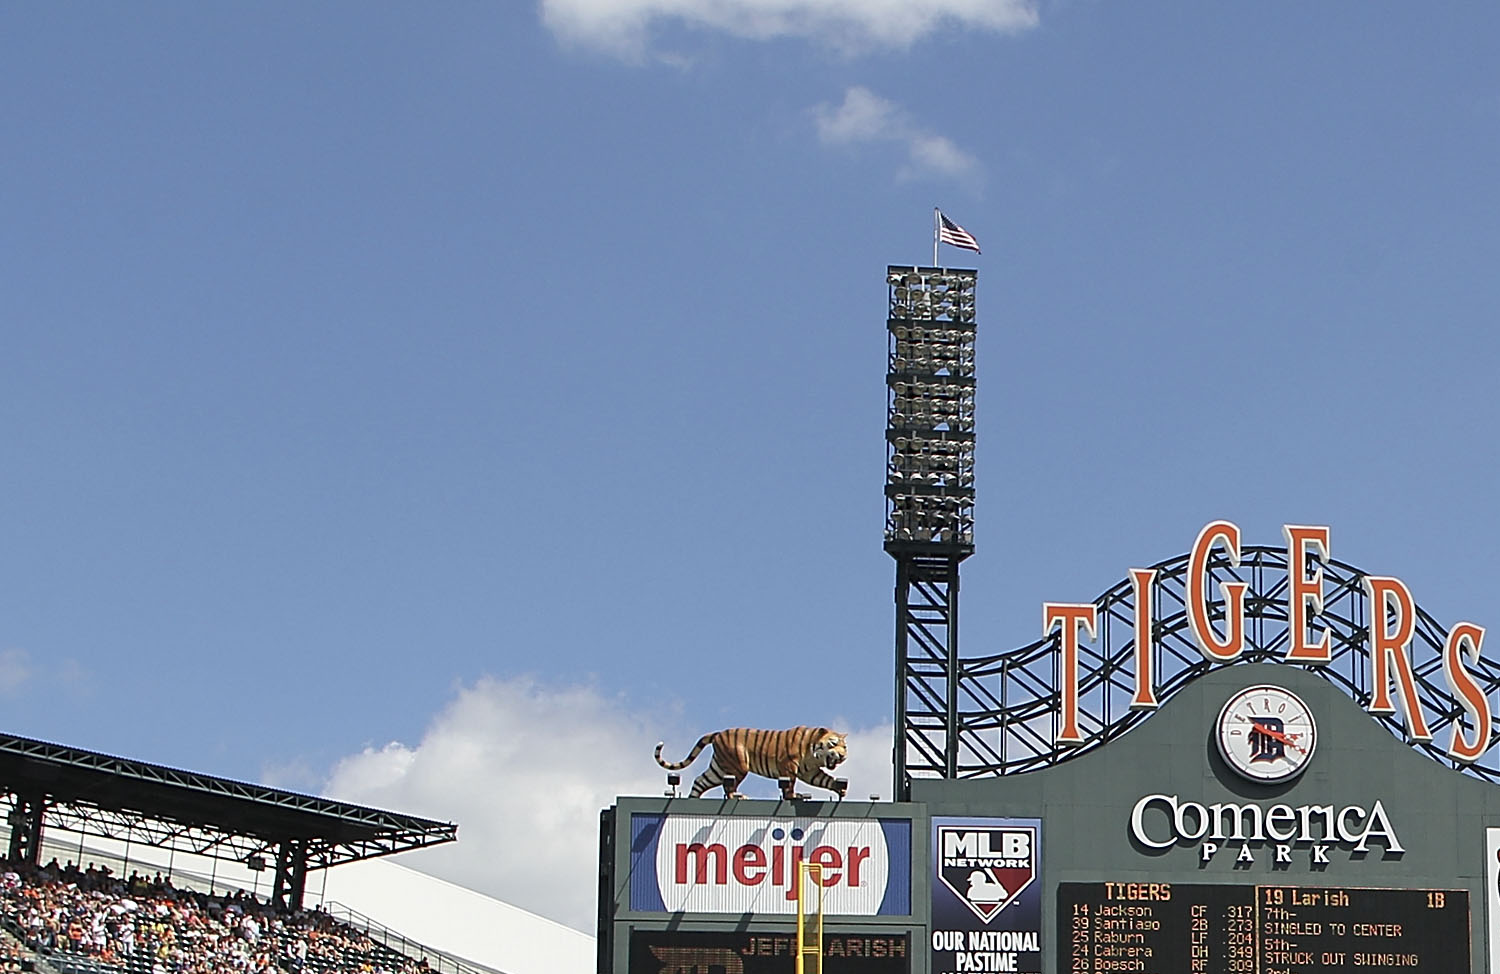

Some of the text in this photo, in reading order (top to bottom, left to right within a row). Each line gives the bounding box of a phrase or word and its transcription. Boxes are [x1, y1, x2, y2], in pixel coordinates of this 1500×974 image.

[1042, 519, 1494, 765] TIGERS
[944, 832, 1030, 859] MLB
[1203, 842, 1331, 865] PARK
[675, 828, 870, 901] meijer
[944, 858, 1030, 868] NETWORK
[1105, 882, 1172, 901] TIGERS
[1265, 889, 1445, 909] 19 Larish 1B
[1072, 904, 1152, 916] 14 Jackson
[1072, 918, 1160, 930] 39 Santiago
[1265, 923, 1402, 936] SINGLED TO CENTER
[932, 931, 1040, 951] OUR NATIONAL
[1072, 931, 1144, 943] 25 Raburn
[1072, 945, 1152, 956] 24 Cabrera
[956, 952, 1017, 972] PASTIME
[1072, 959, 1144, 970] 26 Boesch
[1265, 953, 1418, 966] STRUCK OUT SWINGING
